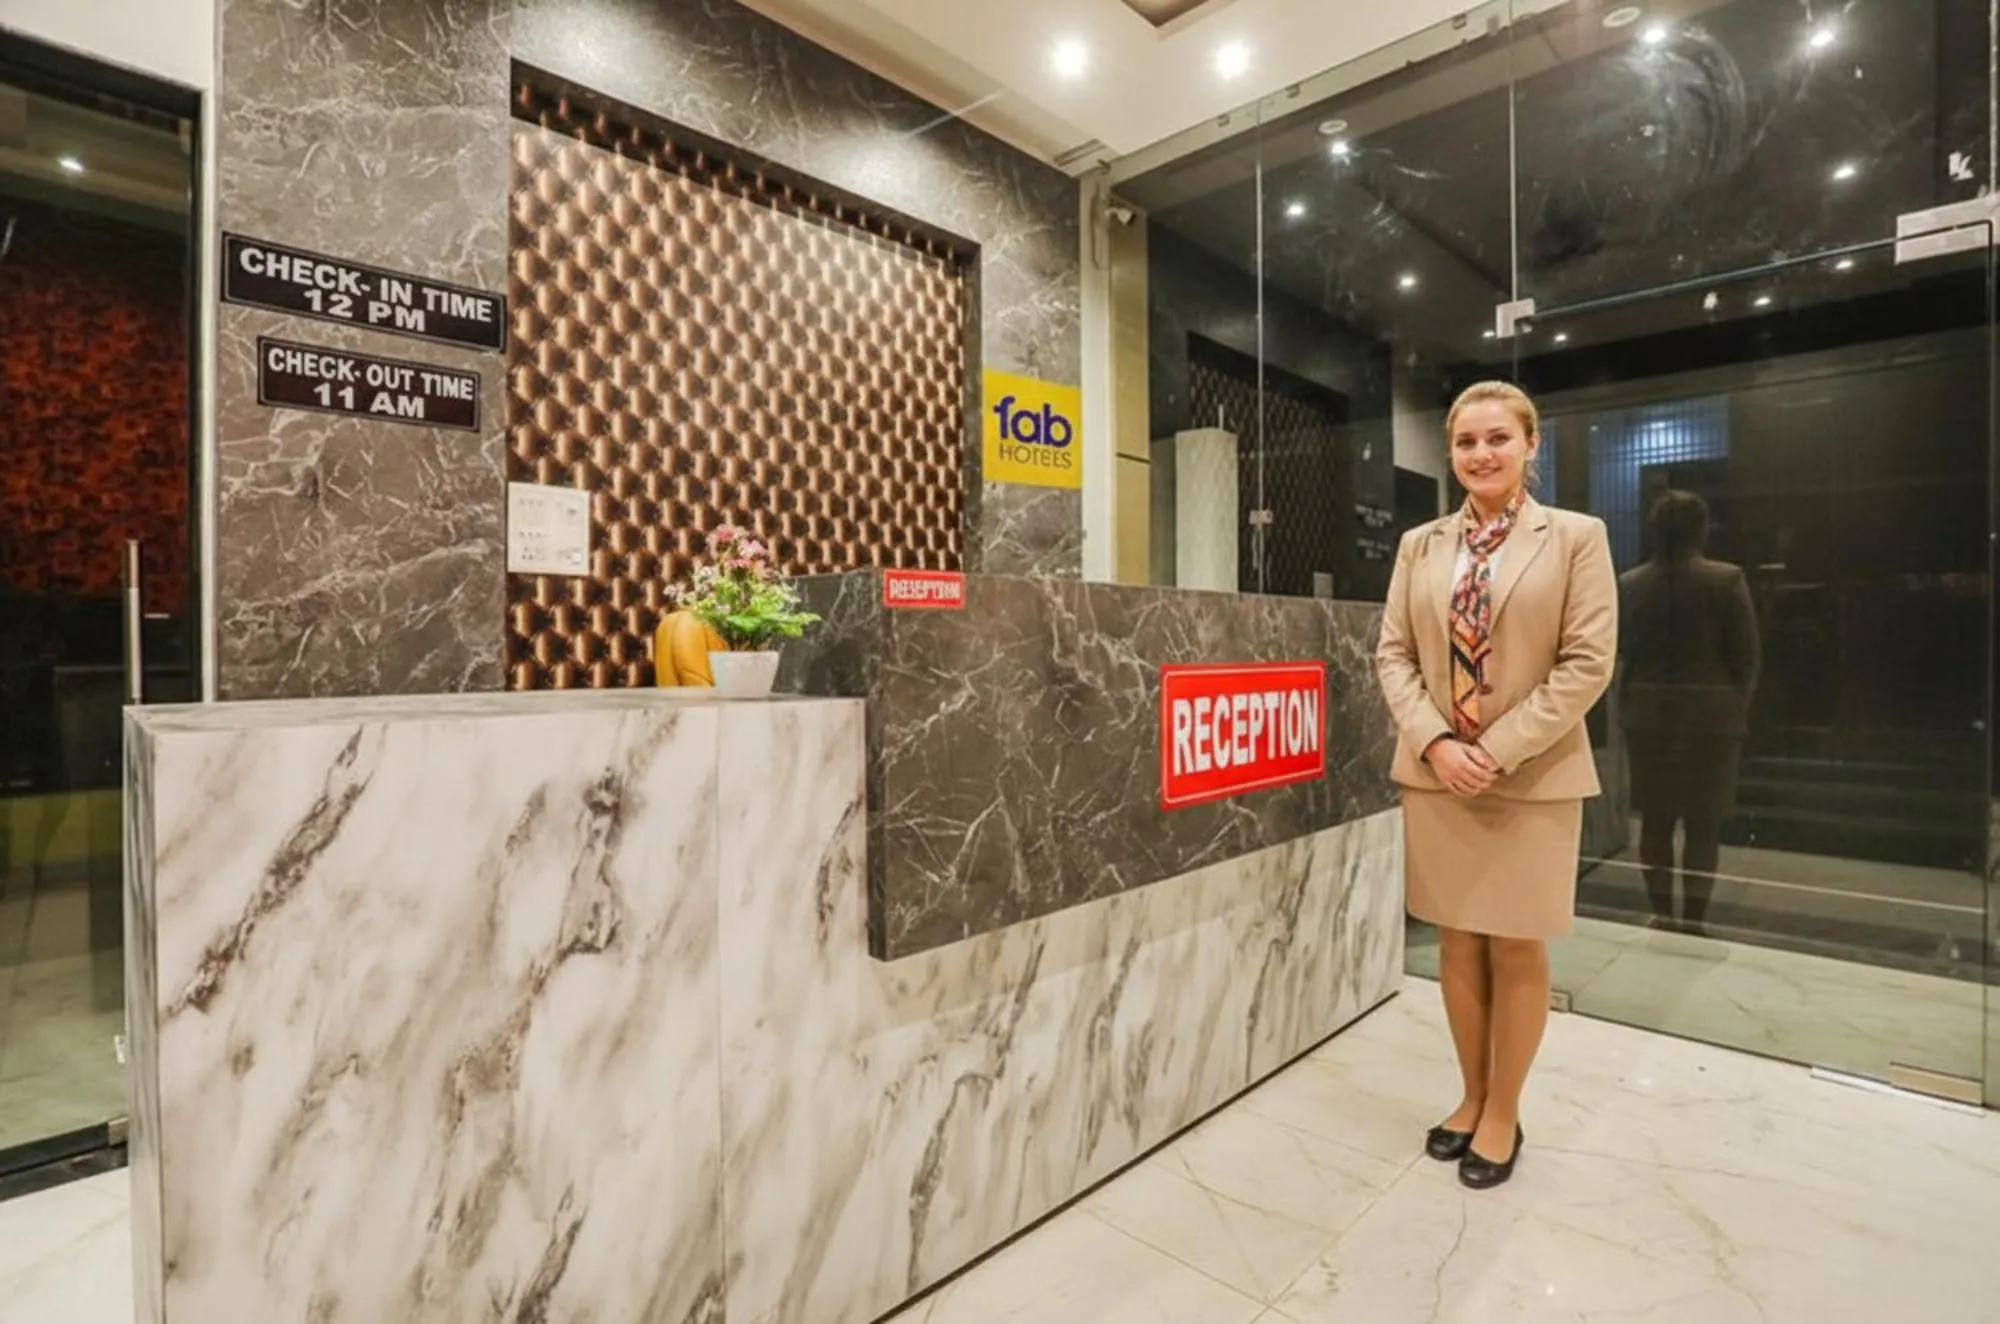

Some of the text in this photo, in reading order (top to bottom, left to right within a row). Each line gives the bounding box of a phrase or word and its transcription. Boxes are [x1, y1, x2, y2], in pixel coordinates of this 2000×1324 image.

[304, 288, 426, 332] 12 PM
[379, 278, 413, 306] IN
[422, 286, 493, 322] TIME
[313, 383, 426, 419] 11 AM
[420, 372, 475, 400] TIME
[993, 395, 1072, 448] fab
[1173, 687, 1319, 777] RECEPTION
